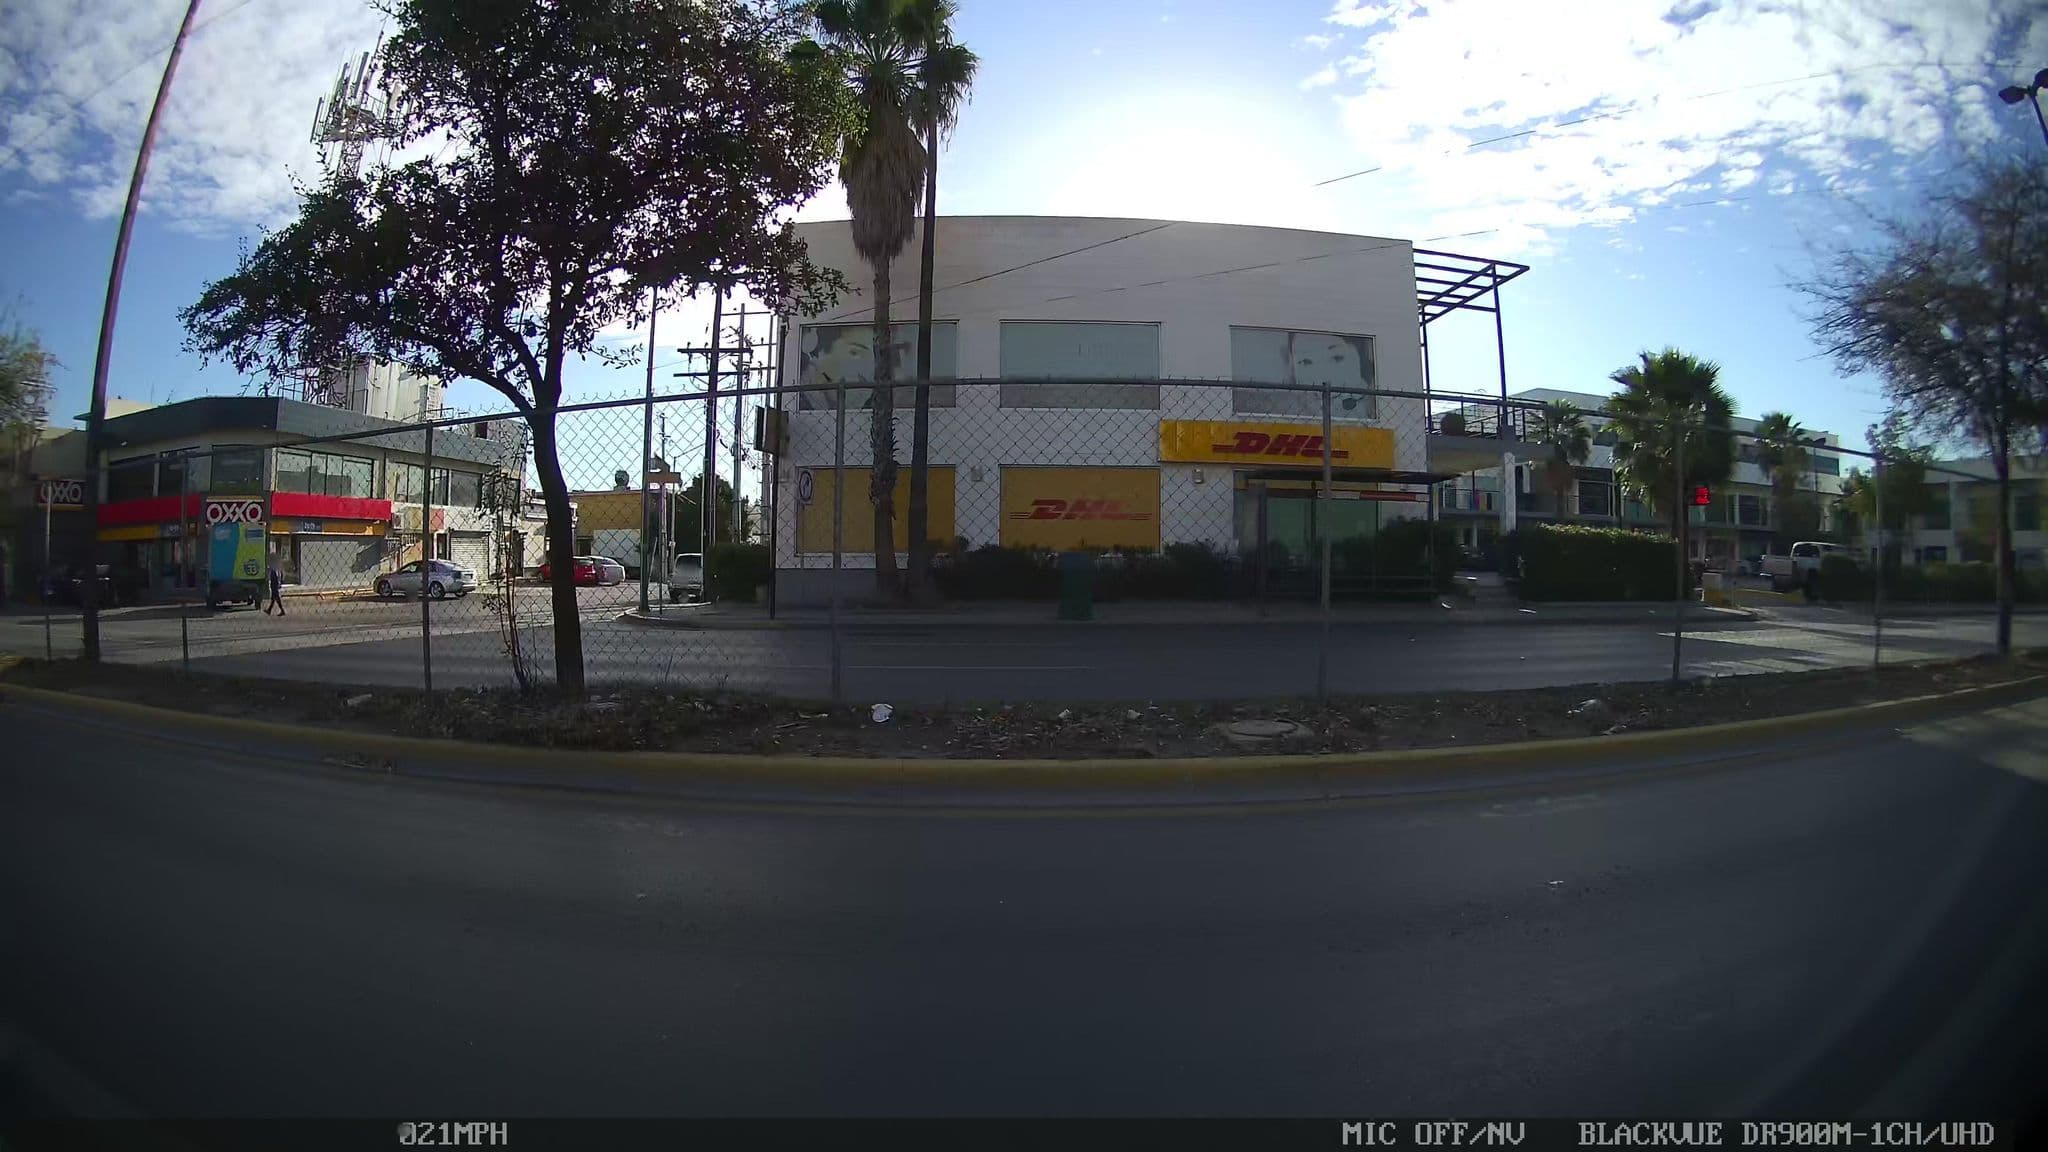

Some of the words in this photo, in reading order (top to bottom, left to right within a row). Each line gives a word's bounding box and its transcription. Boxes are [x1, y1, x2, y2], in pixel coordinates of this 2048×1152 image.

[1230, 432, 1332, 458] DHL
[40, 479, 82, 502] OXXO
[206, 500, 263, 523] OXXO
[1029, 499, 1130, 520] DHL
